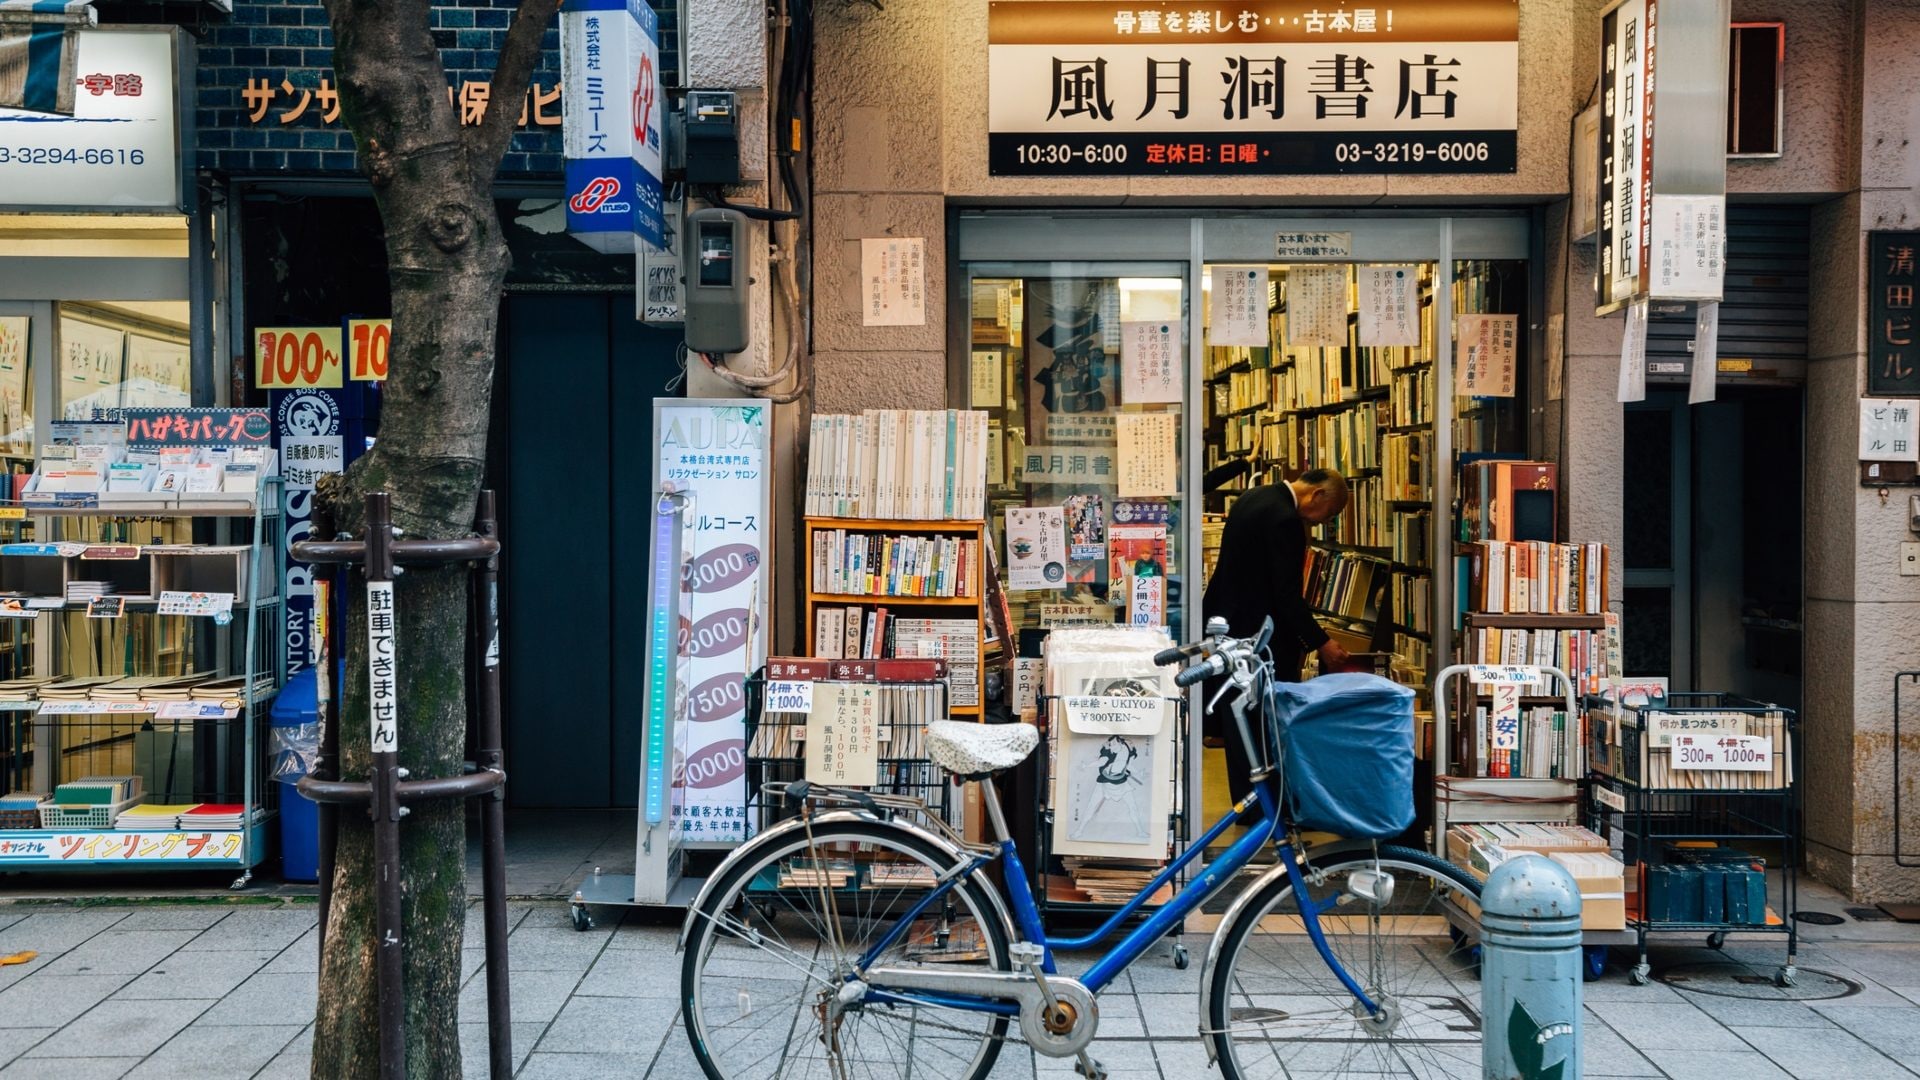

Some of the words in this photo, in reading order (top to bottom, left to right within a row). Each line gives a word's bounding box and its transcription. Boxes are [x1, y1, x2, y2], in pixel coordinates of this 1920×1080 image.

[586, 16, 600, 70] 株式会社
[1045, 53, 1462, 122] 風月洞書店
[587, 77, 607, 153] ミューズ
[1016, 143, 1128, 165] 10:30-6:00
[1335, 142, 1489, 164] 03-3219-6006
[1620, 17, 1637, 279] 風月洞書店
[1884, 246, 1914, 380] 清田ビル
[1149, 325, 1159, 377] 店内の全商品
[128, 413, 246, 442] ハガキパック
[286, 444, 339, 460] 自販機の周りに
[668, 469, 730, 479] リラクゼーション
[734, 469, 758, 479] サロン
[680, 454, 750, 465] 本格台湾式専門店
[370, 589, 395, 745] 駐車できません
[839, 665, 865, 676] 弥生
[823, 725, 832, 772] 風月洞書店
[1680, 747, 1714, 763] 300円
